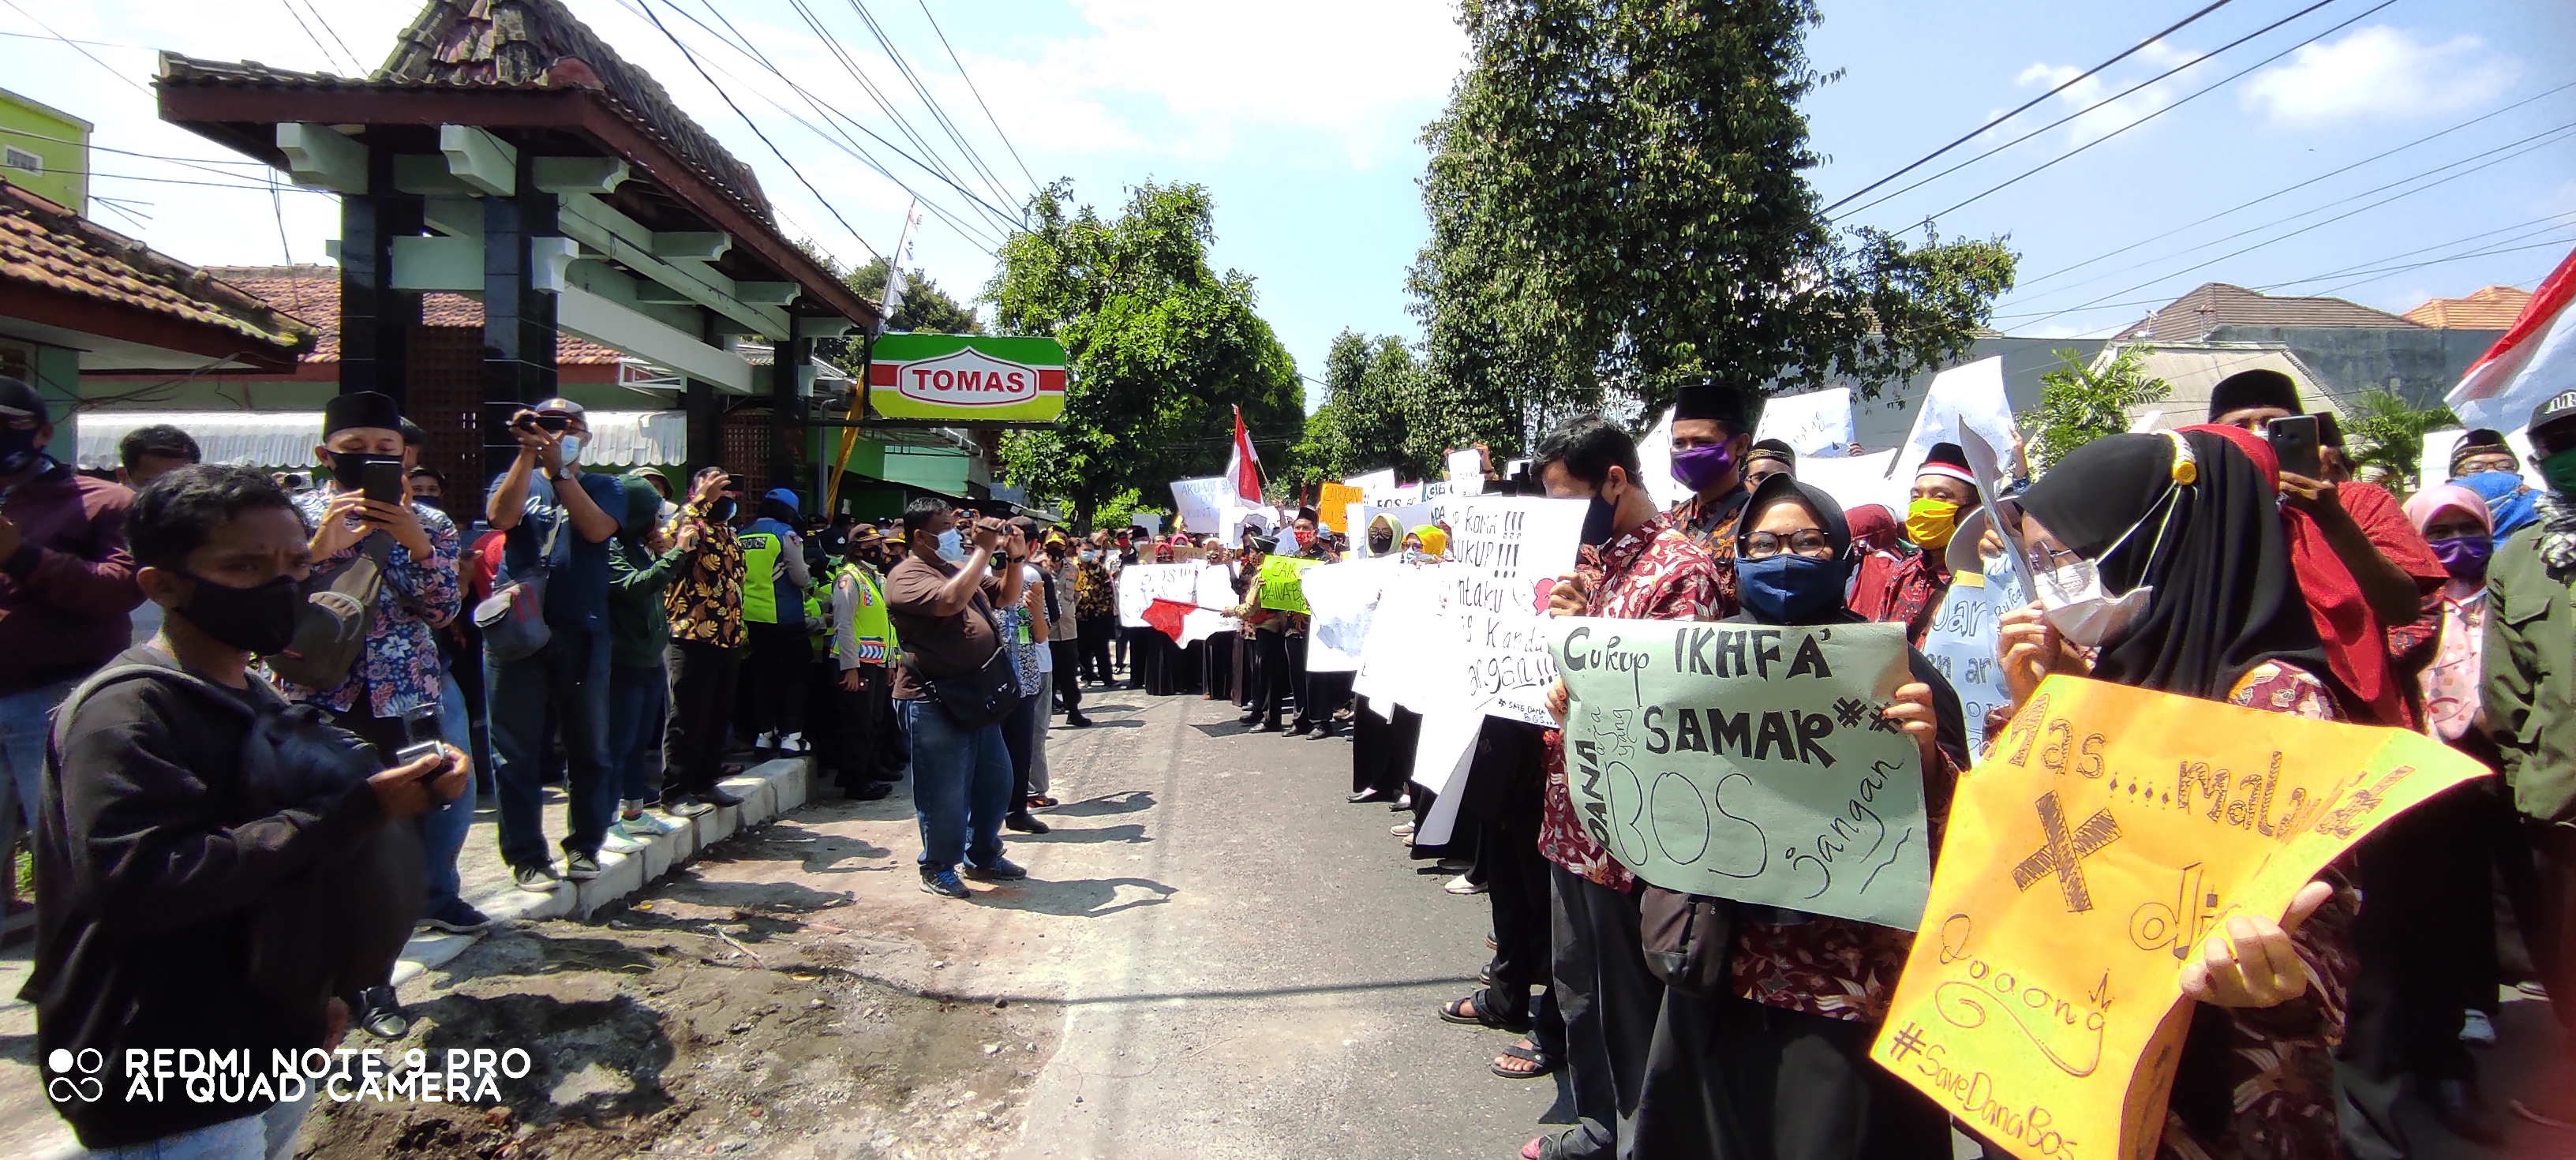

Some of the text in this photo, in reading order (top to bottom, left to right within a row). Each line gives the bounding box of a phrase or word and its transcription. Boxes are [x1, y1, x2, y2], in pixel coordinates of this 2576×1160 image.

[912, 369, 1025, 393] TOMAS
[1563, 627, 1649, 709] Cukup
[1612, 709, 1638, 760] yang
[1605, 761, 1768, 879] BOS
[1889, 1020, 2078, 1160] #SaveDanaBos
